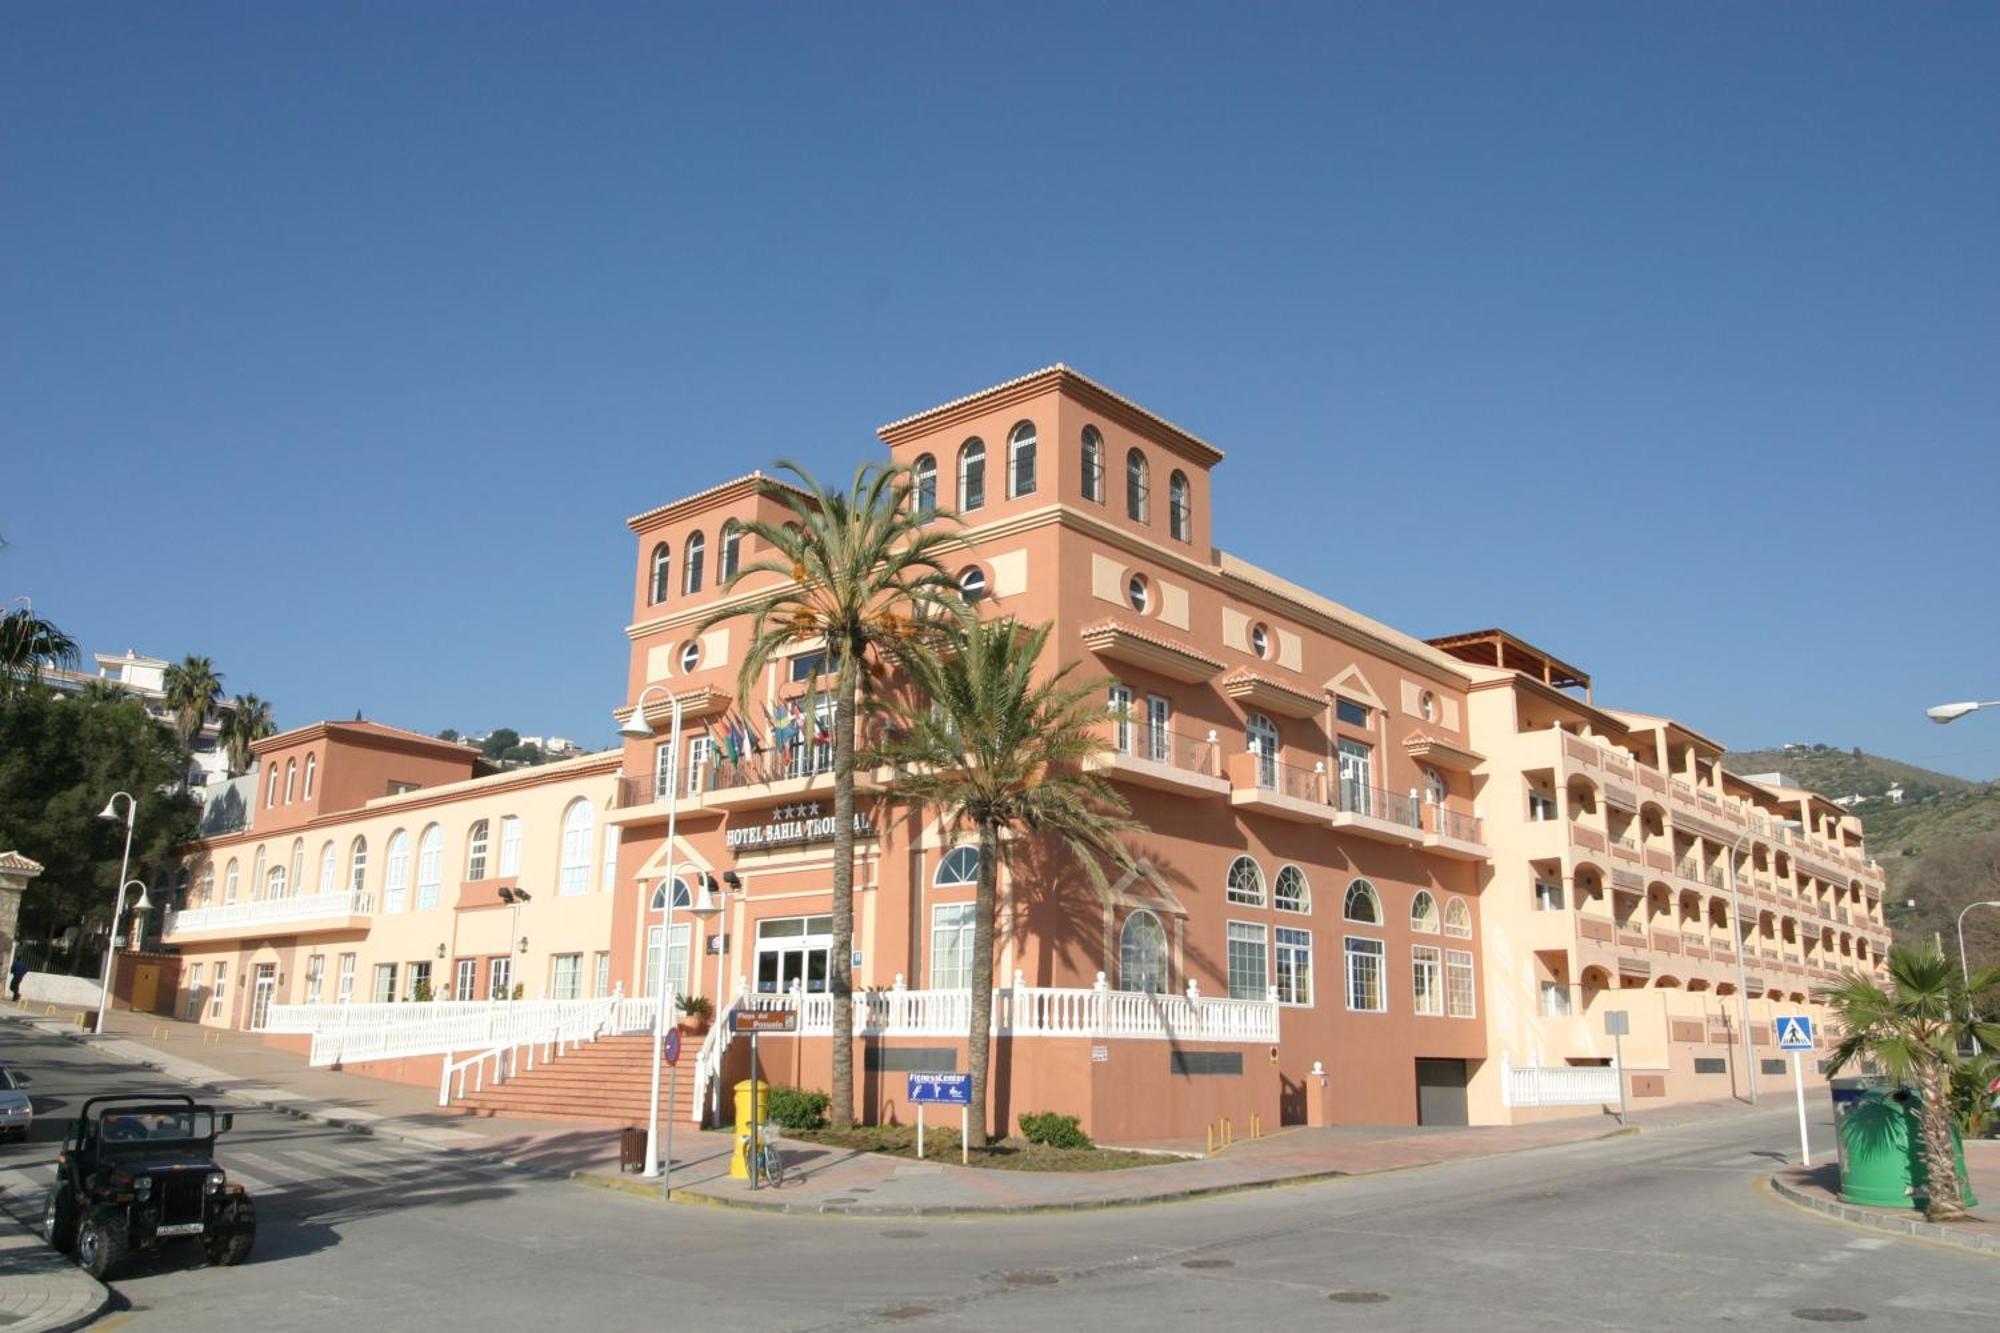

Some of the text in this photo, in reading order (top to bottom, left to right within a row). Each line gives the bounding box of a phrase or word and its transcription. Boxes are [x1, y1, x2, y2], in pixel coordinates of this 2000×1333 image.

[727, 812, 869, 846] HOTEL BAHIA TROAL
